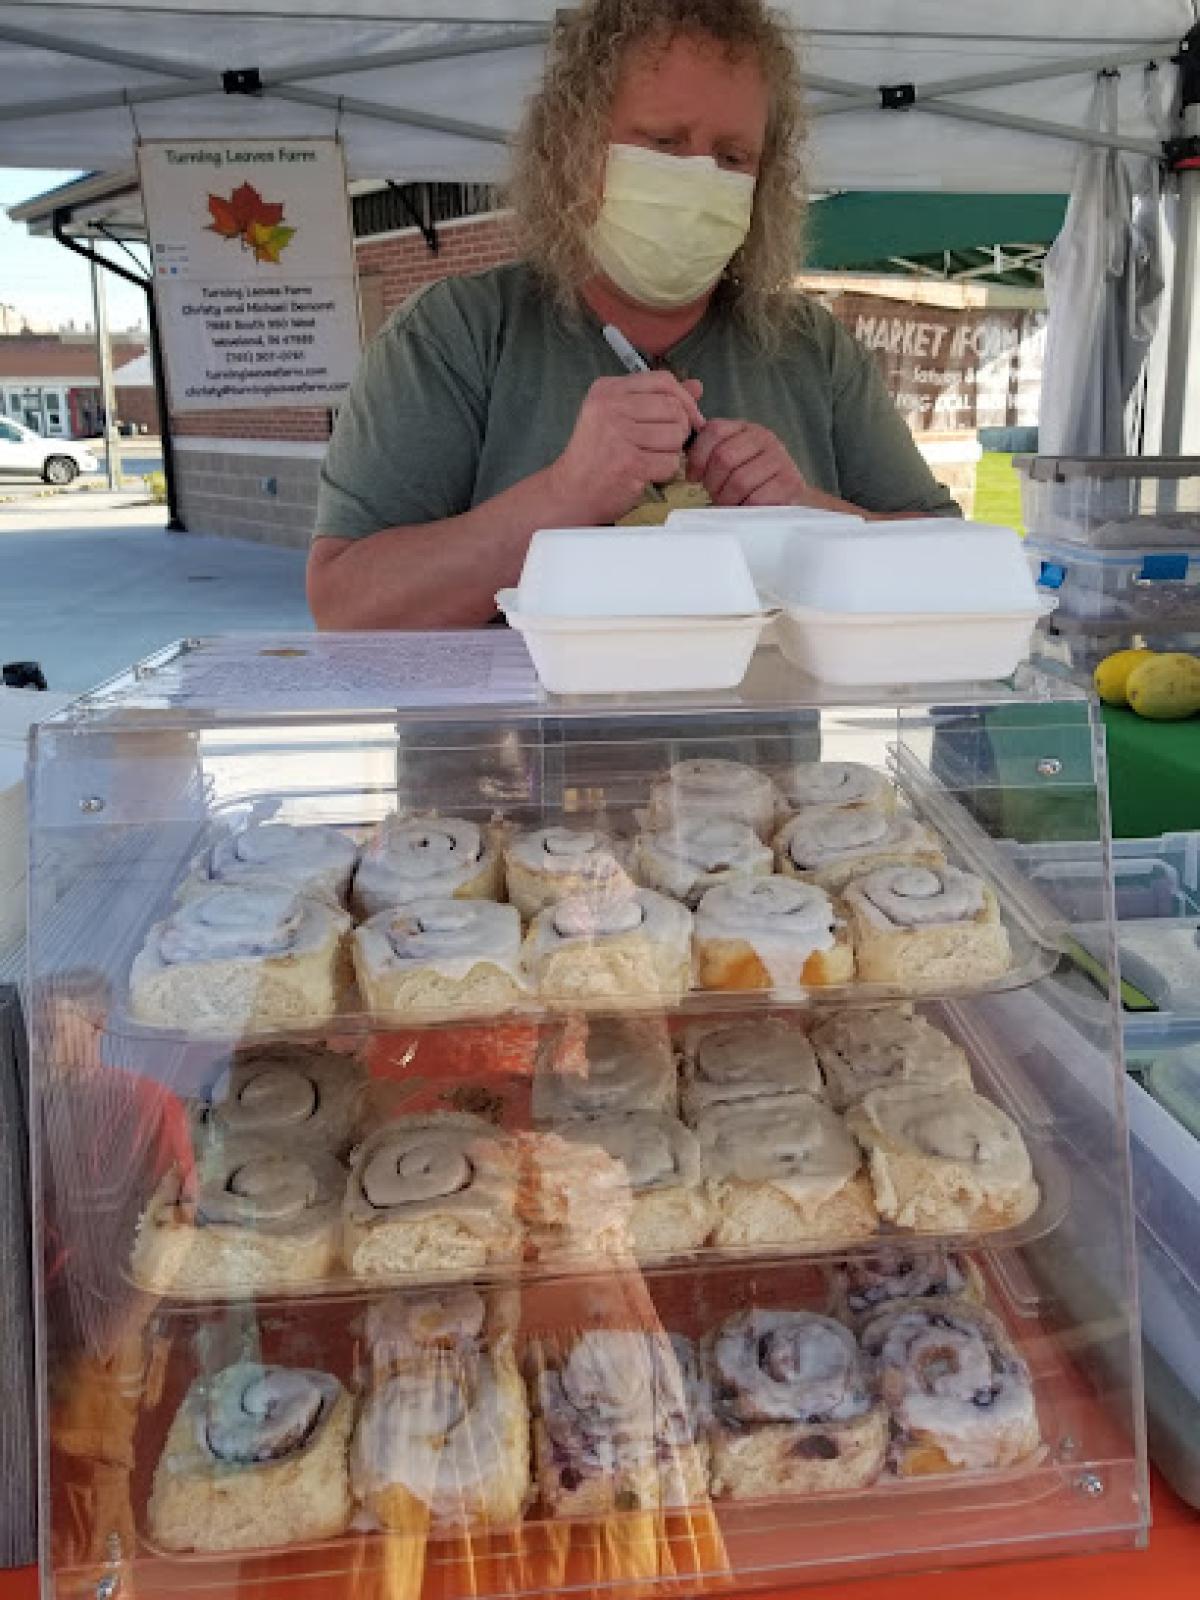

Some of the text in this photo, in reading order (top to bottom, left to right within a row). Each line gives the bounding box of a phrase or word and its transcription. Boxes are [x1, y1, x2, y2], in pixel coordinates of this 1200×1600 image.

[166, 147, 316, 168] Turning Leaves Farm
[203, 285, 313, 300] Turning Leaves Farm
[223, 302, 245, 313] and
[246, 301, 289, 313] Michael
[856, 314, 949, 359] MARKET
